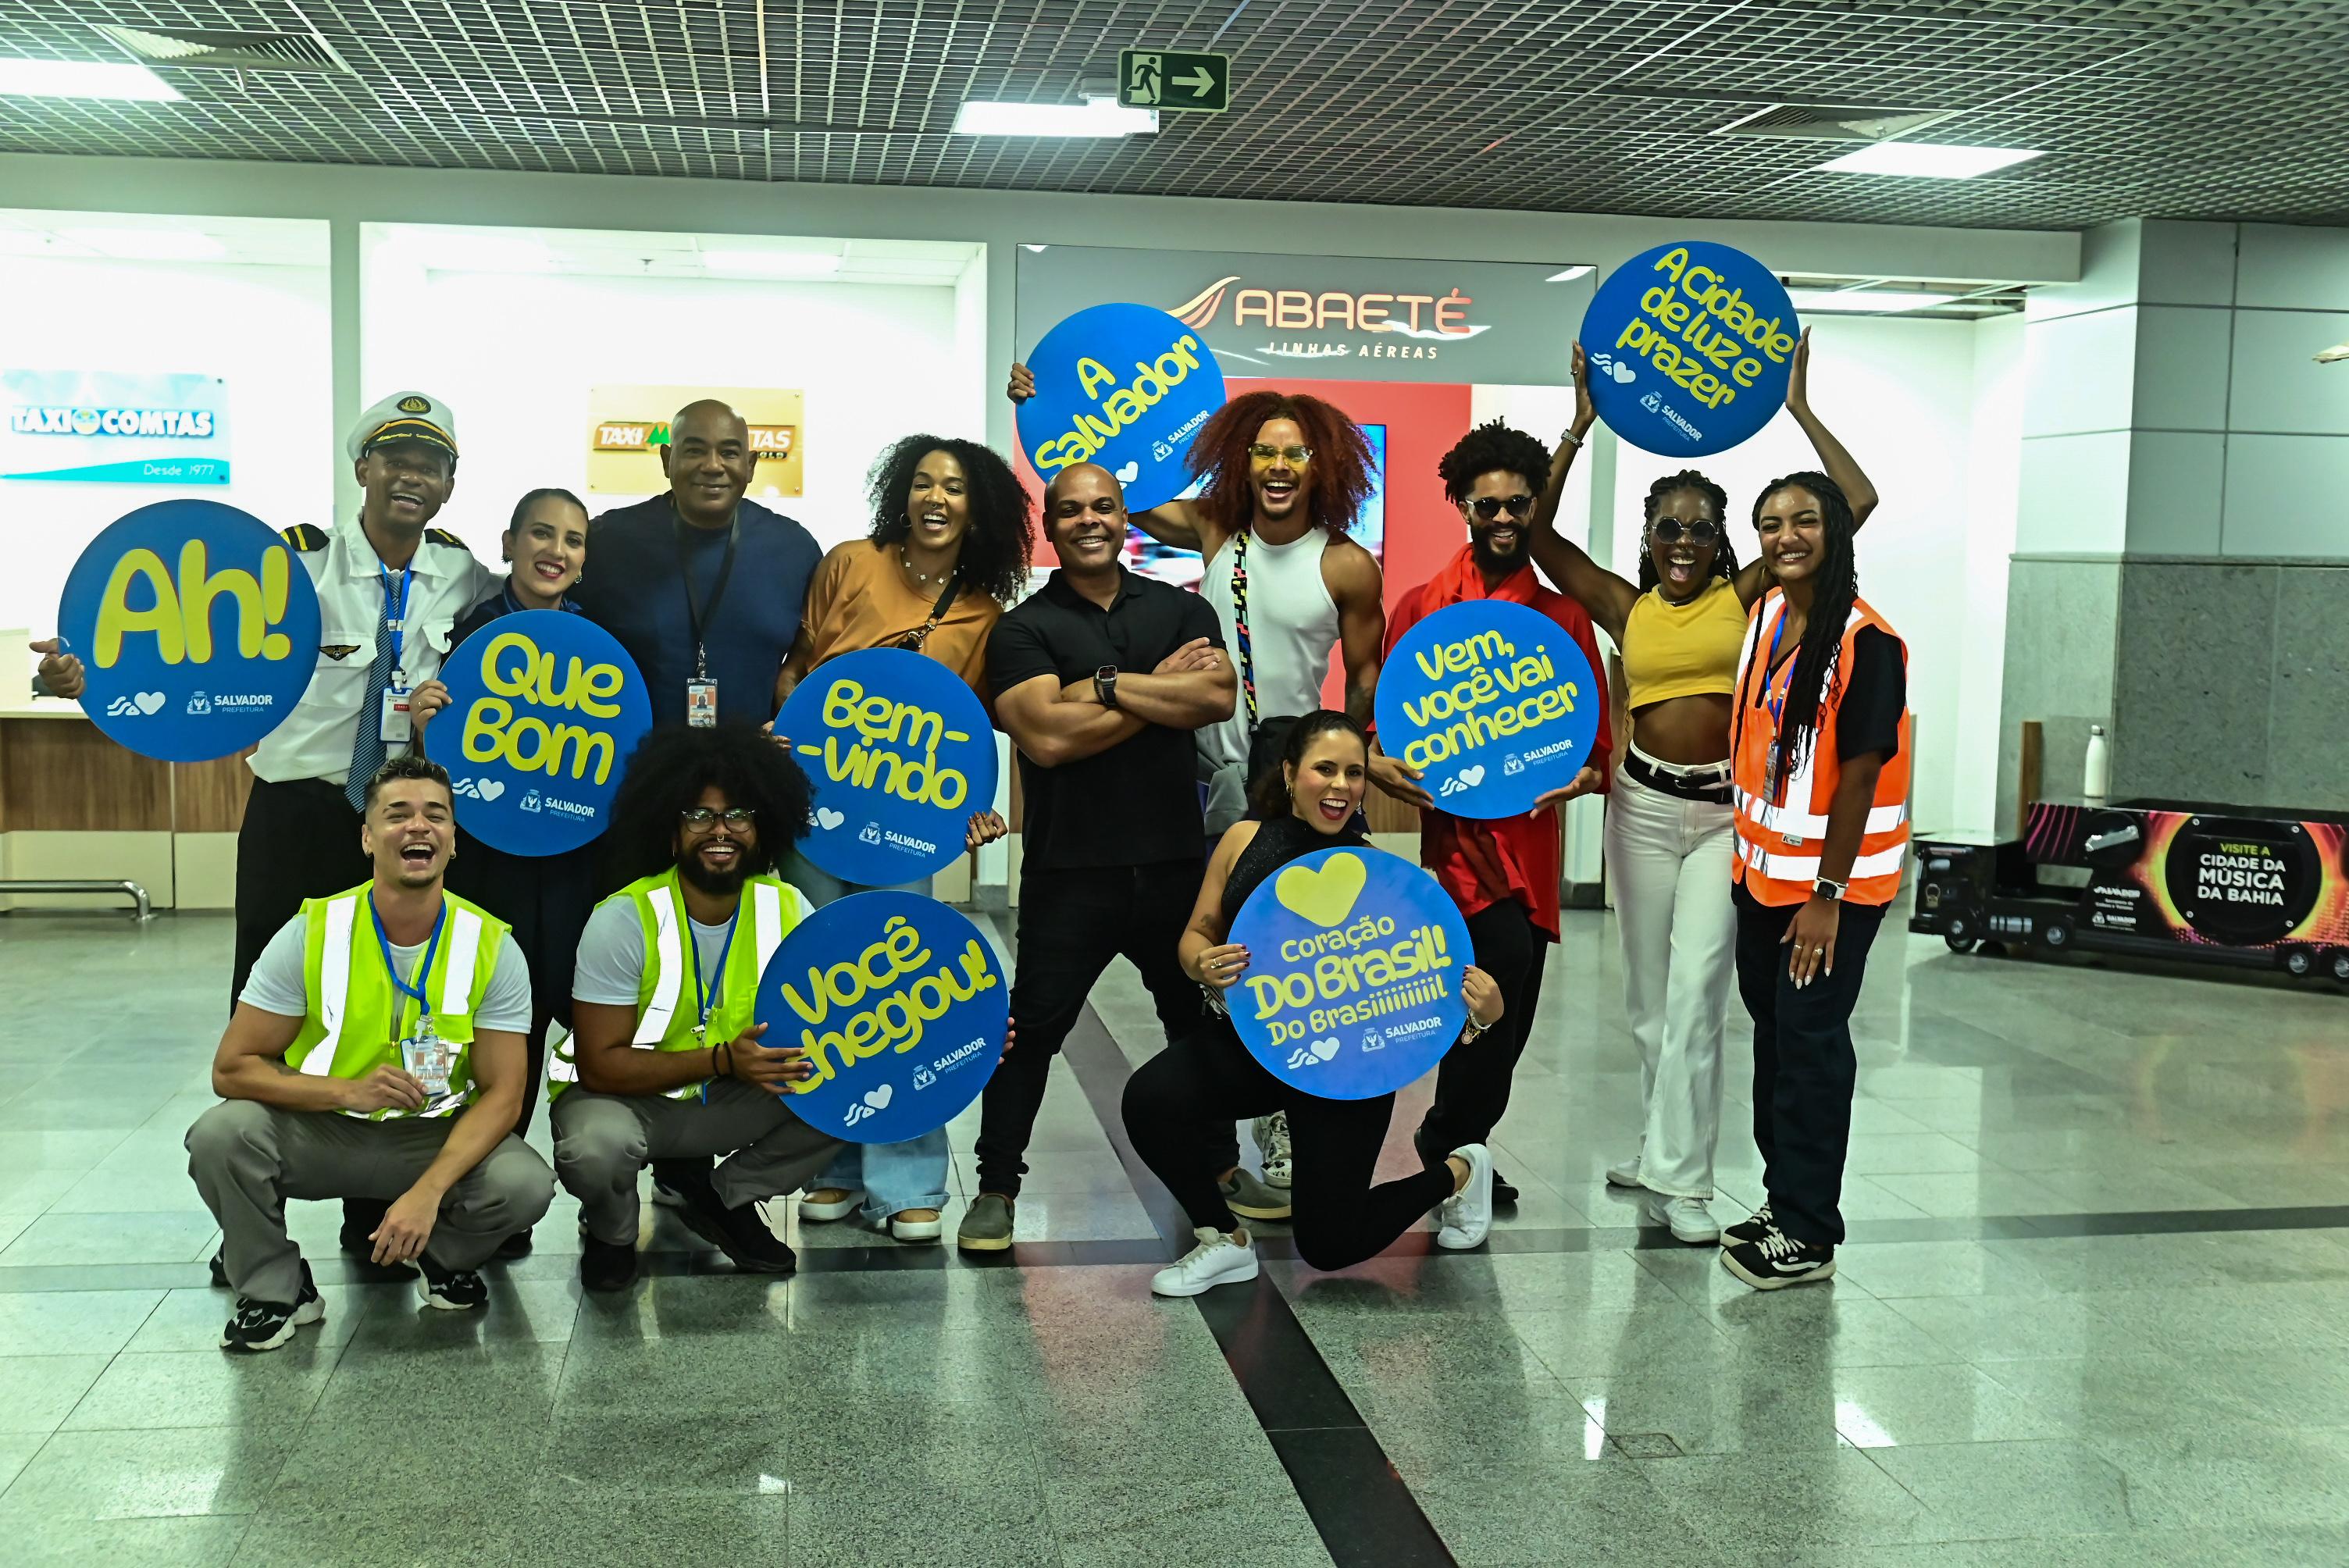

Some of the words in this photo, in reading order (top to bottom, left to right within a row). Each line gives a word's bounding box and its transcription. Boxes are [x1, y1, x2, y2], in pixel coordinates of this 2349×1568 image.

[1235, 287, 1473, 333] ABAETÉ
[1653, 248, 1688, 283] A
[1681, 266, 1795, 363] Cidade
[1269, 342, 1347, 357] LINHAS
[1358, 342, 1438, 359] AÉREAS
[1640, 286, 1690, 332] de
[1681, 311, 1742, 370] luz
[1732, 358, 1763, 387] e
[1076, 357, 1116, 400] A
[1615, 317, 1736, 409] prazer
[12, 408, 73, 433] TAXI
[102, 409, 213, 437] COMTAS
[599, 426, 645, 446] TAXI
[749, 429, 791, 449] TAS
[1167, 410, 1210, 444] SALVADOR
[1661, 404, 1702, 442] SALVADOR
[143, 463, 182, 476] Desde
[188, 464, 215, 476] 1977
[93, 539, 291, 669] Ah!
[1415, 629, 1515, 681] Vem,
[480, 632, 624, 718] Que
[1403, 666, 1499, 727] você
[1493, 644, 1555, 693] vai
[214, 694, 273, 706] SALVADOR
[822, 679, 970, 753] Bem-
[1404, 681, 1578, 770] conhecer
[462, 697, 615, 786] Bom
[1523, 739, 1574, 763] SALVADOR
[797, 736, 968, 810] -vindo
[1532, 750, 1569, 766] PREFEITURA
[544, 797, 595, 818] SALVADOR
[549, 809, 585, 822] PREFEITURA
[884, 830, 936, 854] SALVADOR
[889, 843, 925, 858] PREFEITURA
[2219, 843, 2258, 856] VISITE
[2261, 846, 2271, 857] A
[2199, 853, 2260, 870] CIDADE
[2262, 858, 2287, 872] DA
[2198, 867, 2286, 891] MÚSICA
[2197, 885, 2223, 900] DA
[2227, 888, 2284, 906] BAHIA
[780, 915, 932, 1025] Você
[1314, 925, 1452, 1000] Brasil!
[1385, 1016, 1442, 1039] SALVADOR
[1395, 1029, 1437, 1044] PREFEITURA
[933, 1037, 986, 1071] SALVADOR
[944, 1051, 982, 1074] PREFEITURA
